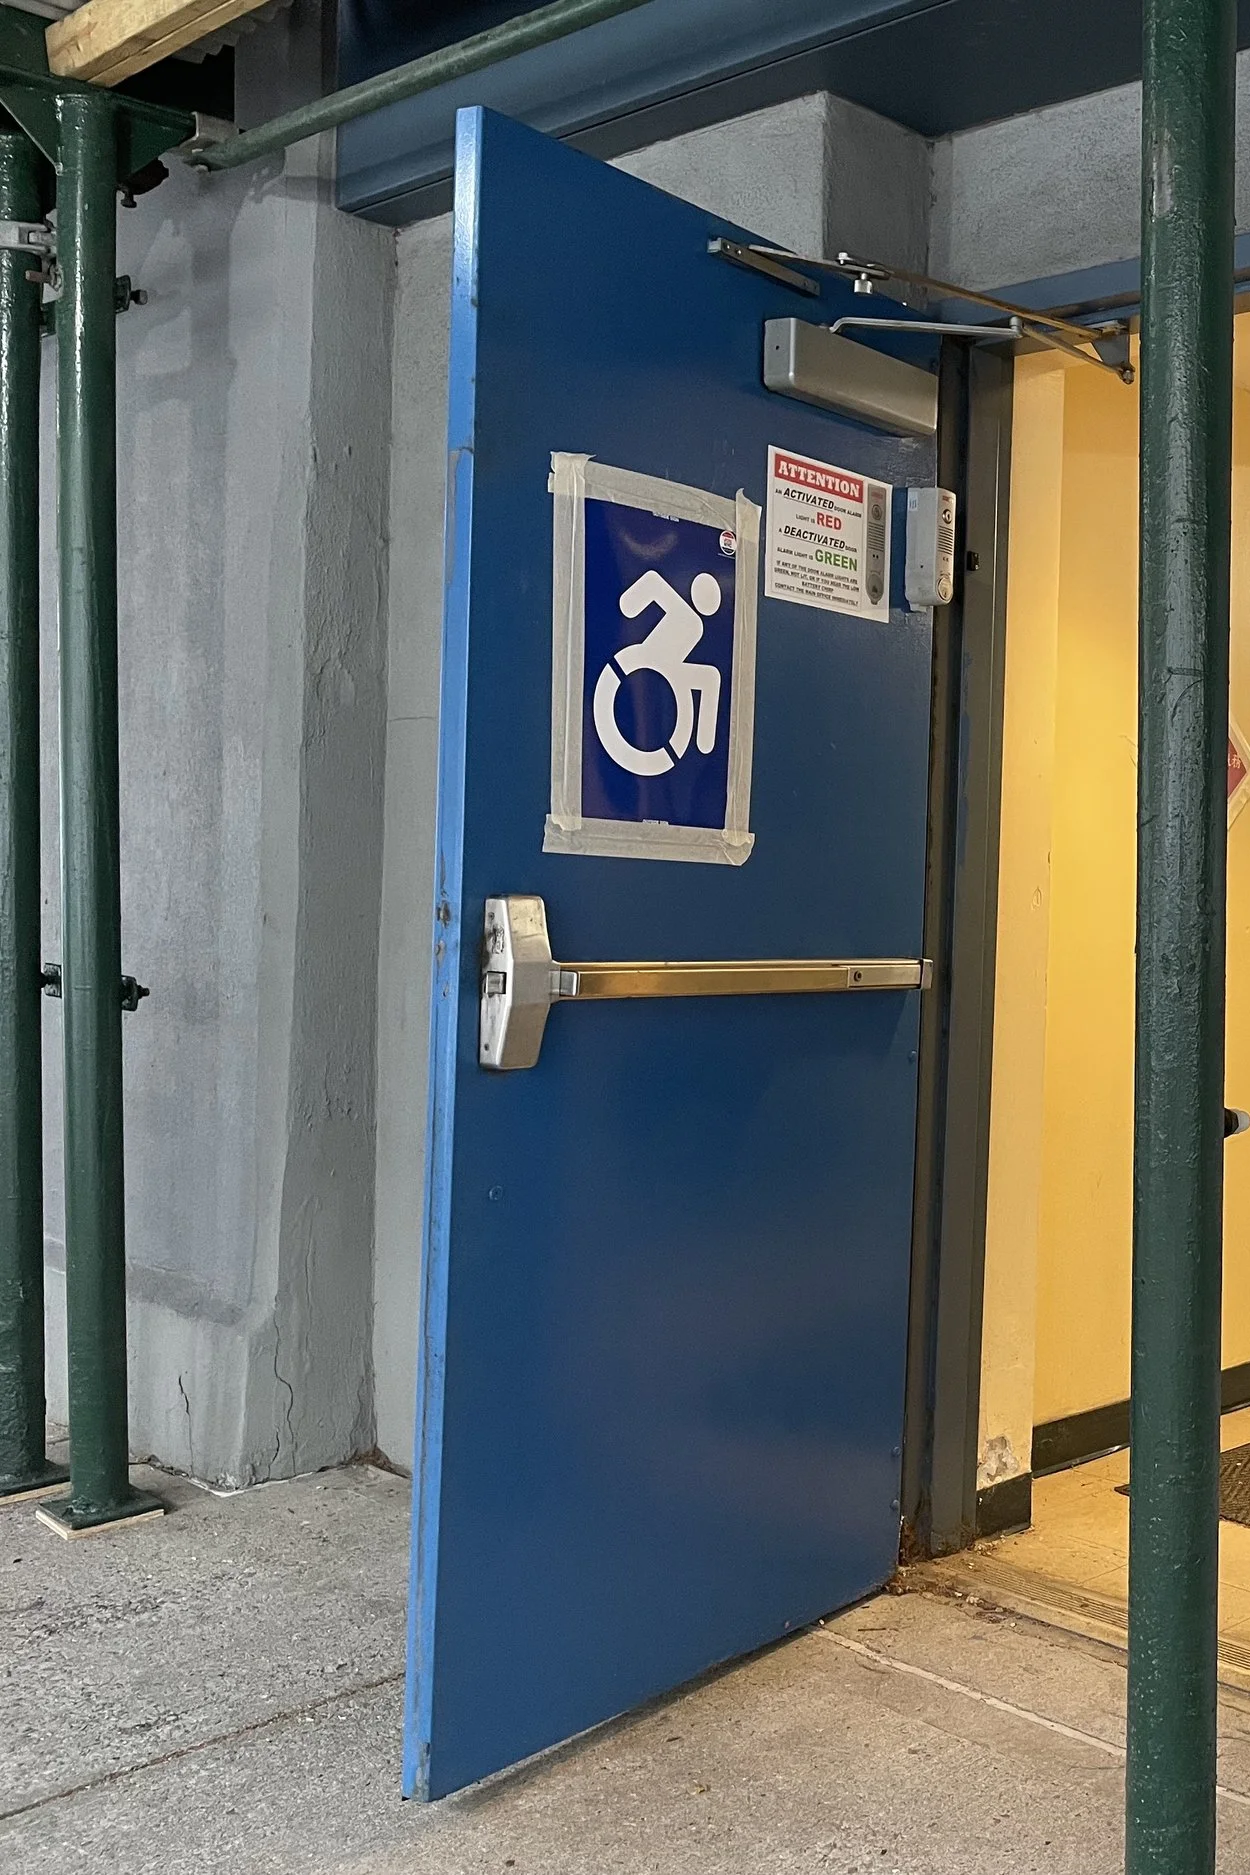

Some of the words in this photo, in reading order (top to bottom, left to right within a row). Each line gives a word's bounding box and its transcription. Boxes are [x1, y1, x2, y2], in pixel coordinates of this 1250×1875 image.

[778, 460, 860, 498] ATTENTION
[784, 488, 834, 510] ACTIVATED
[796, 514, 810, 522] LIGHT
[816, 512, 842, 530] RED
[784, 525, 846, 549] DEACTIVATED
[815, 549, 858, 572] GREEN
[774, 582, 795, 592] CONTACT
